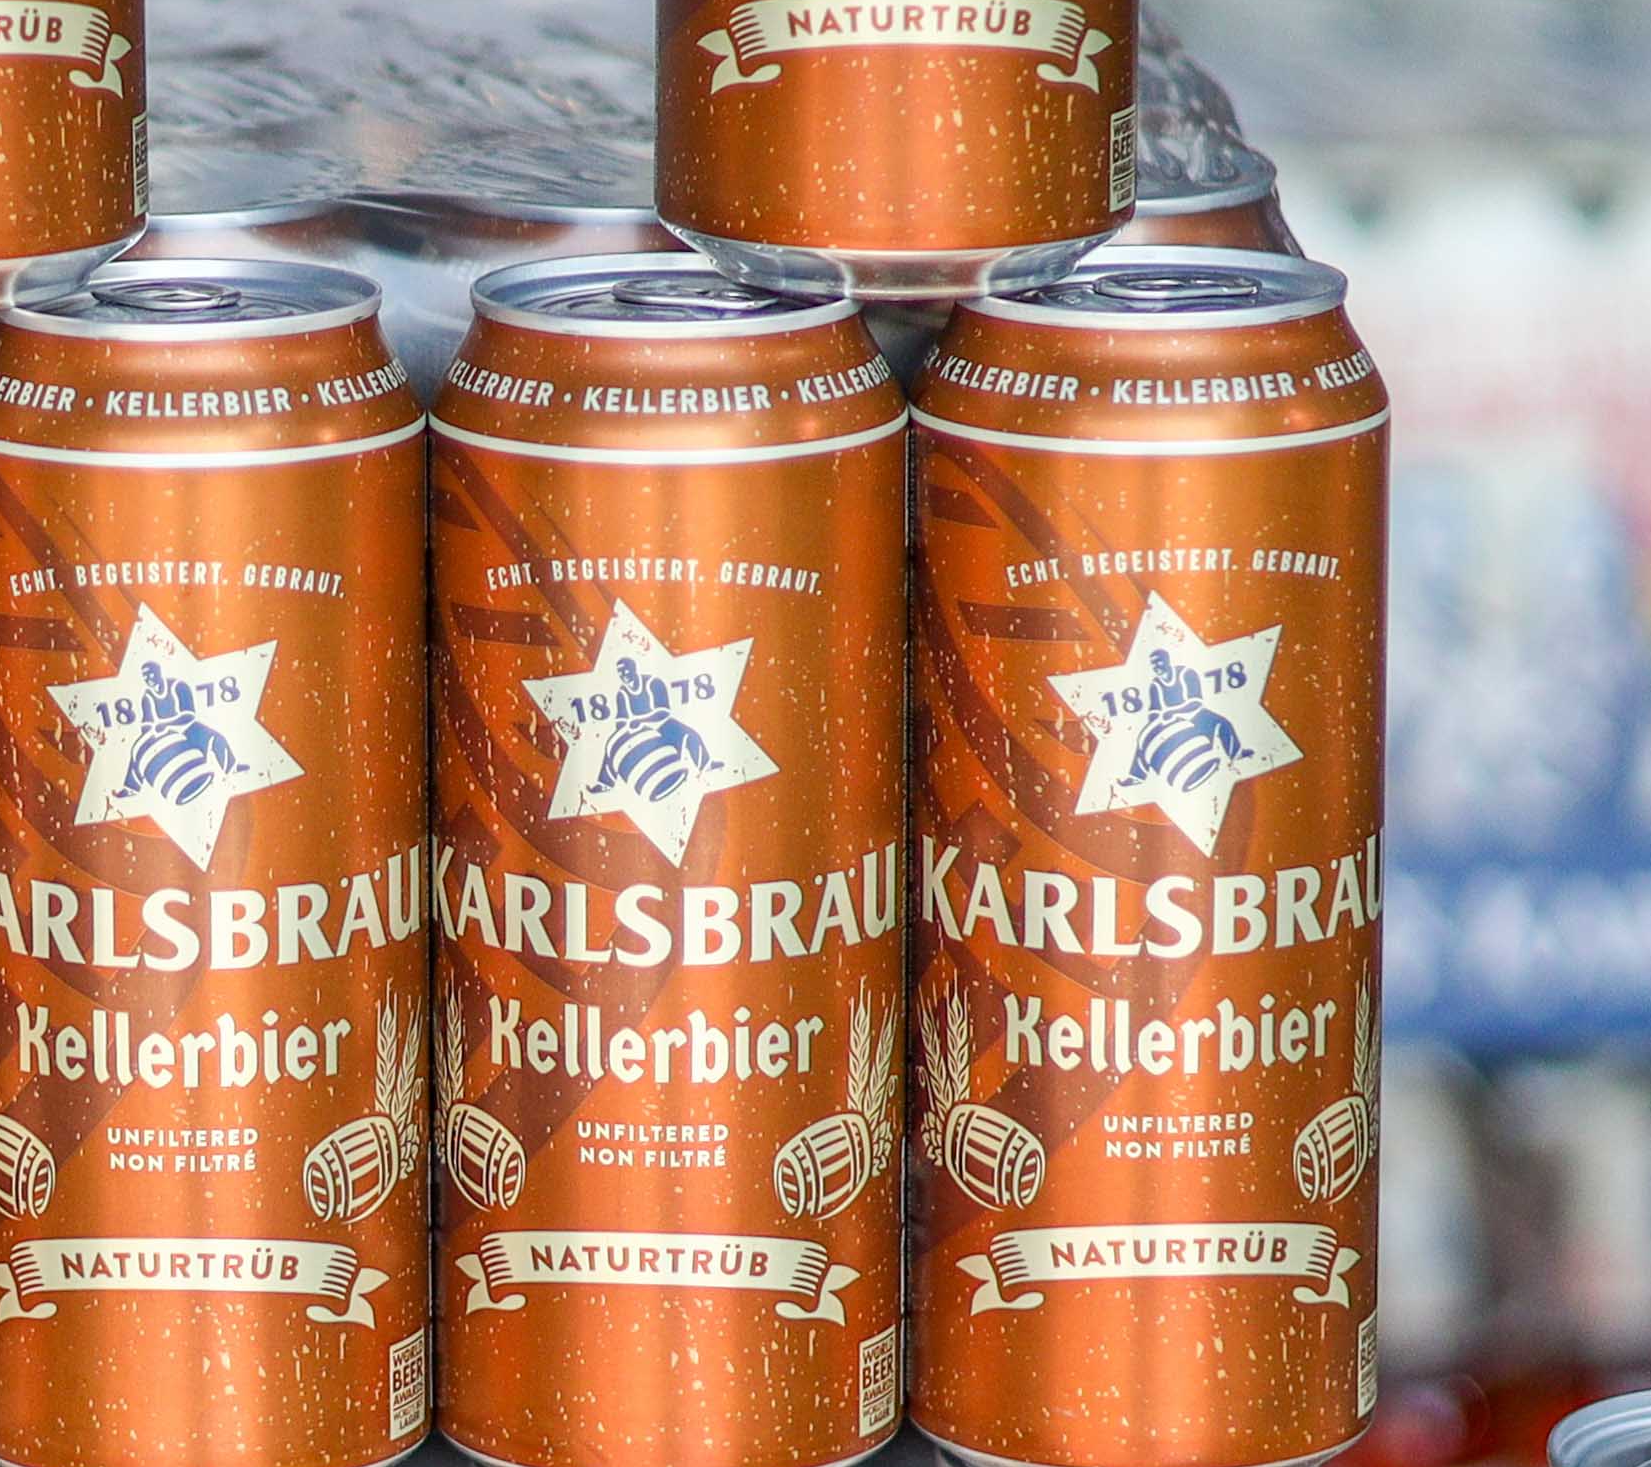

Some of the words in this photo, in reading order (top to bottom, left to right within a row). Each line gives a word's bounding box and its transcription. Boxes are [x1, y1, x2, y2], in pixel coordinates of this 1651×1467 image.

[787, 3, 1032, 37] NATURTRÜB
[105, 388, 293, 418] KELLERBIER
[583, 386, 772, 414] KELLERBIER
[1113, 373, 1296, 404] KELLERBIER
[10, 567, 63, 597] ECHT.
[77, 562, 228, 585] BEGEISTERT.
[244, 564, 345, 597] GEBRAUT.
[1007, 559, 1068, 587] ECHT.
[1082, 549, 1238, 575] BEGEISTERT.
[1253, 549, 1341, 580] GEBRAUT.
[432, 839, 895, 968] KARLSBRÄU
[17, 1001, 352, 1089] Kellerbier
[489, 995, 824, 1085] Kellerbier
[1004, 993, 1336, 1075] Kellerbier
[578, 1121, 728, 1143] UNFILTERED
[1103, 1112, 1254, 1133] UNFILTERED
[580, 1145, 634, 1166] NON
[644, 1145, 726, 1167] FILTRÉ
[1105, 1141, 1161, 1159] NON
[1172, 1135, 1251, 1158] FILTRÉ
[62, 1249, 299, 1281] NATURTRÜB
[530, 1243, 769, 1278] NATURTRÜB
[1050, 1234, 1287, 1269] NATURTRÜB
